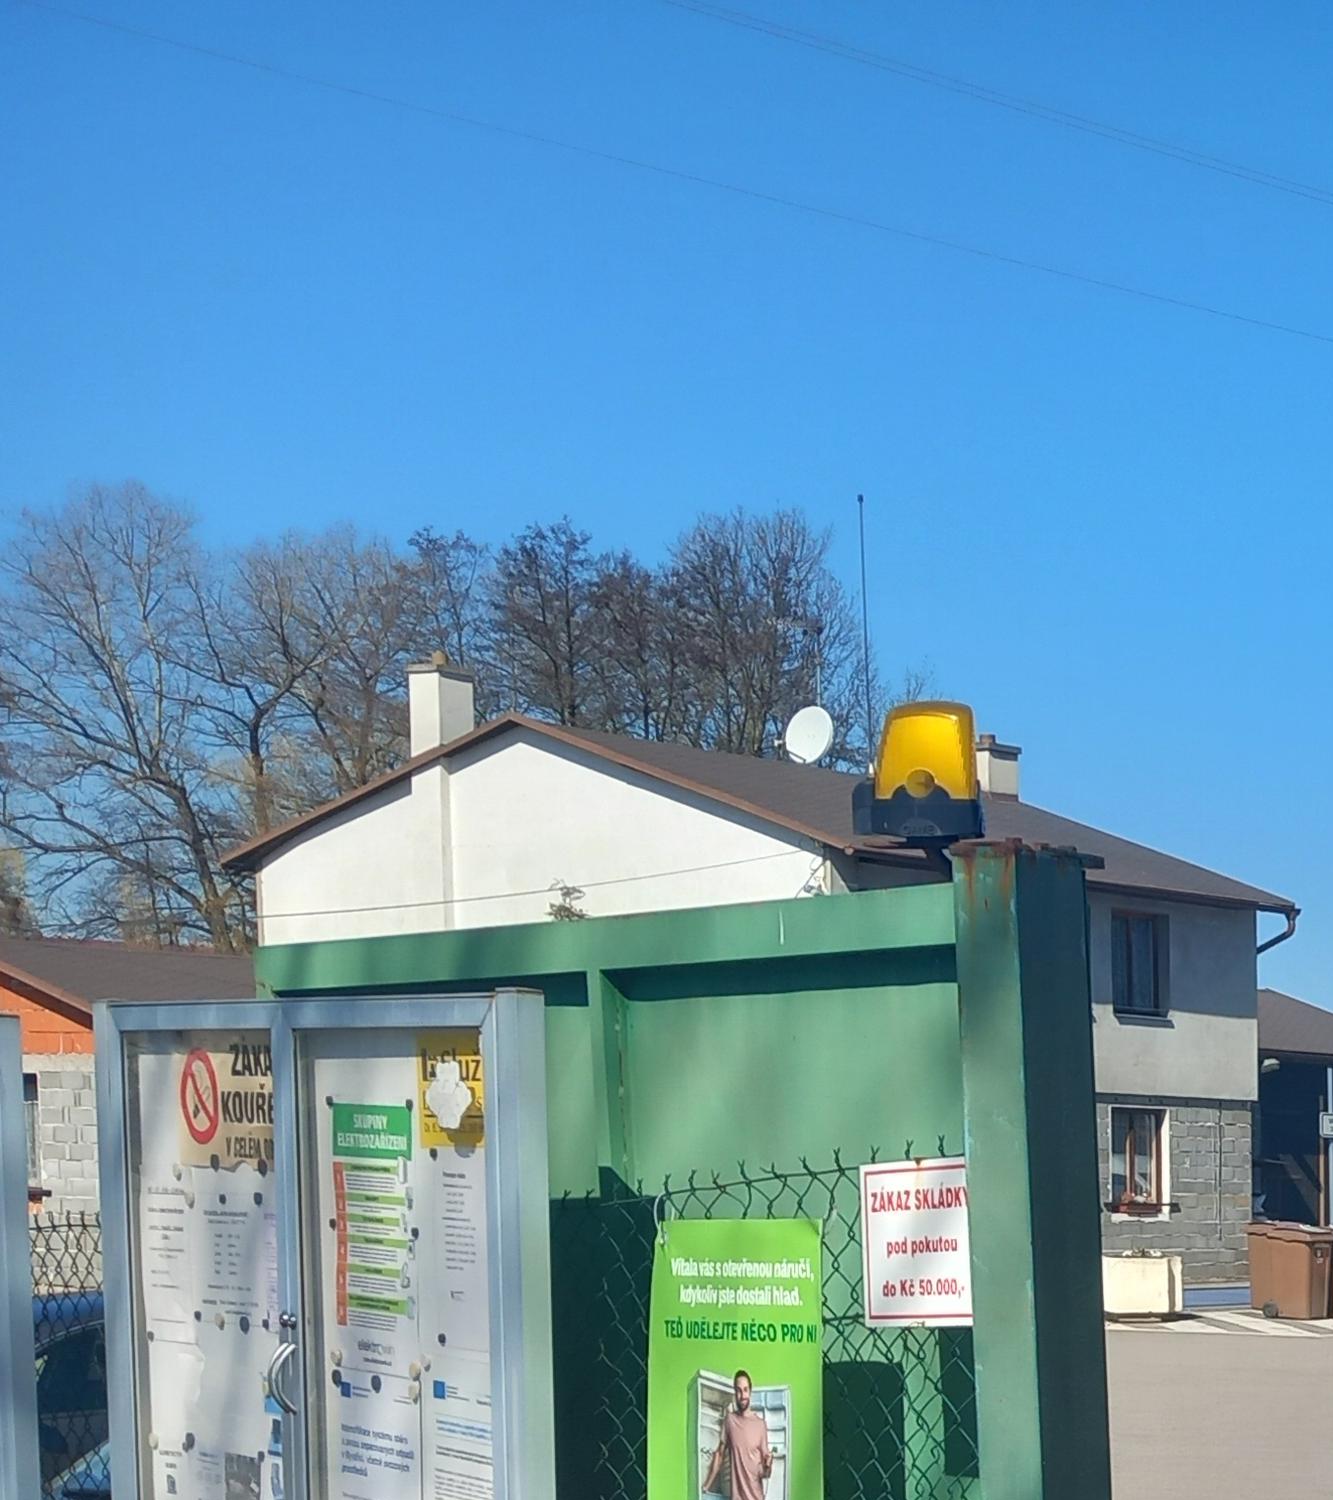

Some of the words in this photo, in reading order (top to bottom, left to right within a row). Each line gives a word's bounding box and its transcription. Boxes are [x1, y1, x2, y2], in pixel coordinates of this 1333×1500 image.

[870, 1187, 911, 1213] ZÁKAZ
[886, 1237, 907, 1258] pod
[911, 1236, 958, 1258] pokutou
[699, 1258, 714, 1276] vás
[722, 1258, 772, 1278] otevřenou
[718, 1285, 735, 1308] jste
[736, 1285, 771, 1306] dostali
[773, 1285, 803, 1306] hlad.
[882, 1280, 896, 1297] do
[900, 1279, 915, 1297] Kč
[919, 1278, 965, 1299] 50.000,-
[664, 1315, 683, 1338] TEĎ
[686, 1316, 738, 1340] UDĚLEJTE
[741, 1318, 777, 1342] NĚCO
[781, 1324, 803, 1343] PRO
